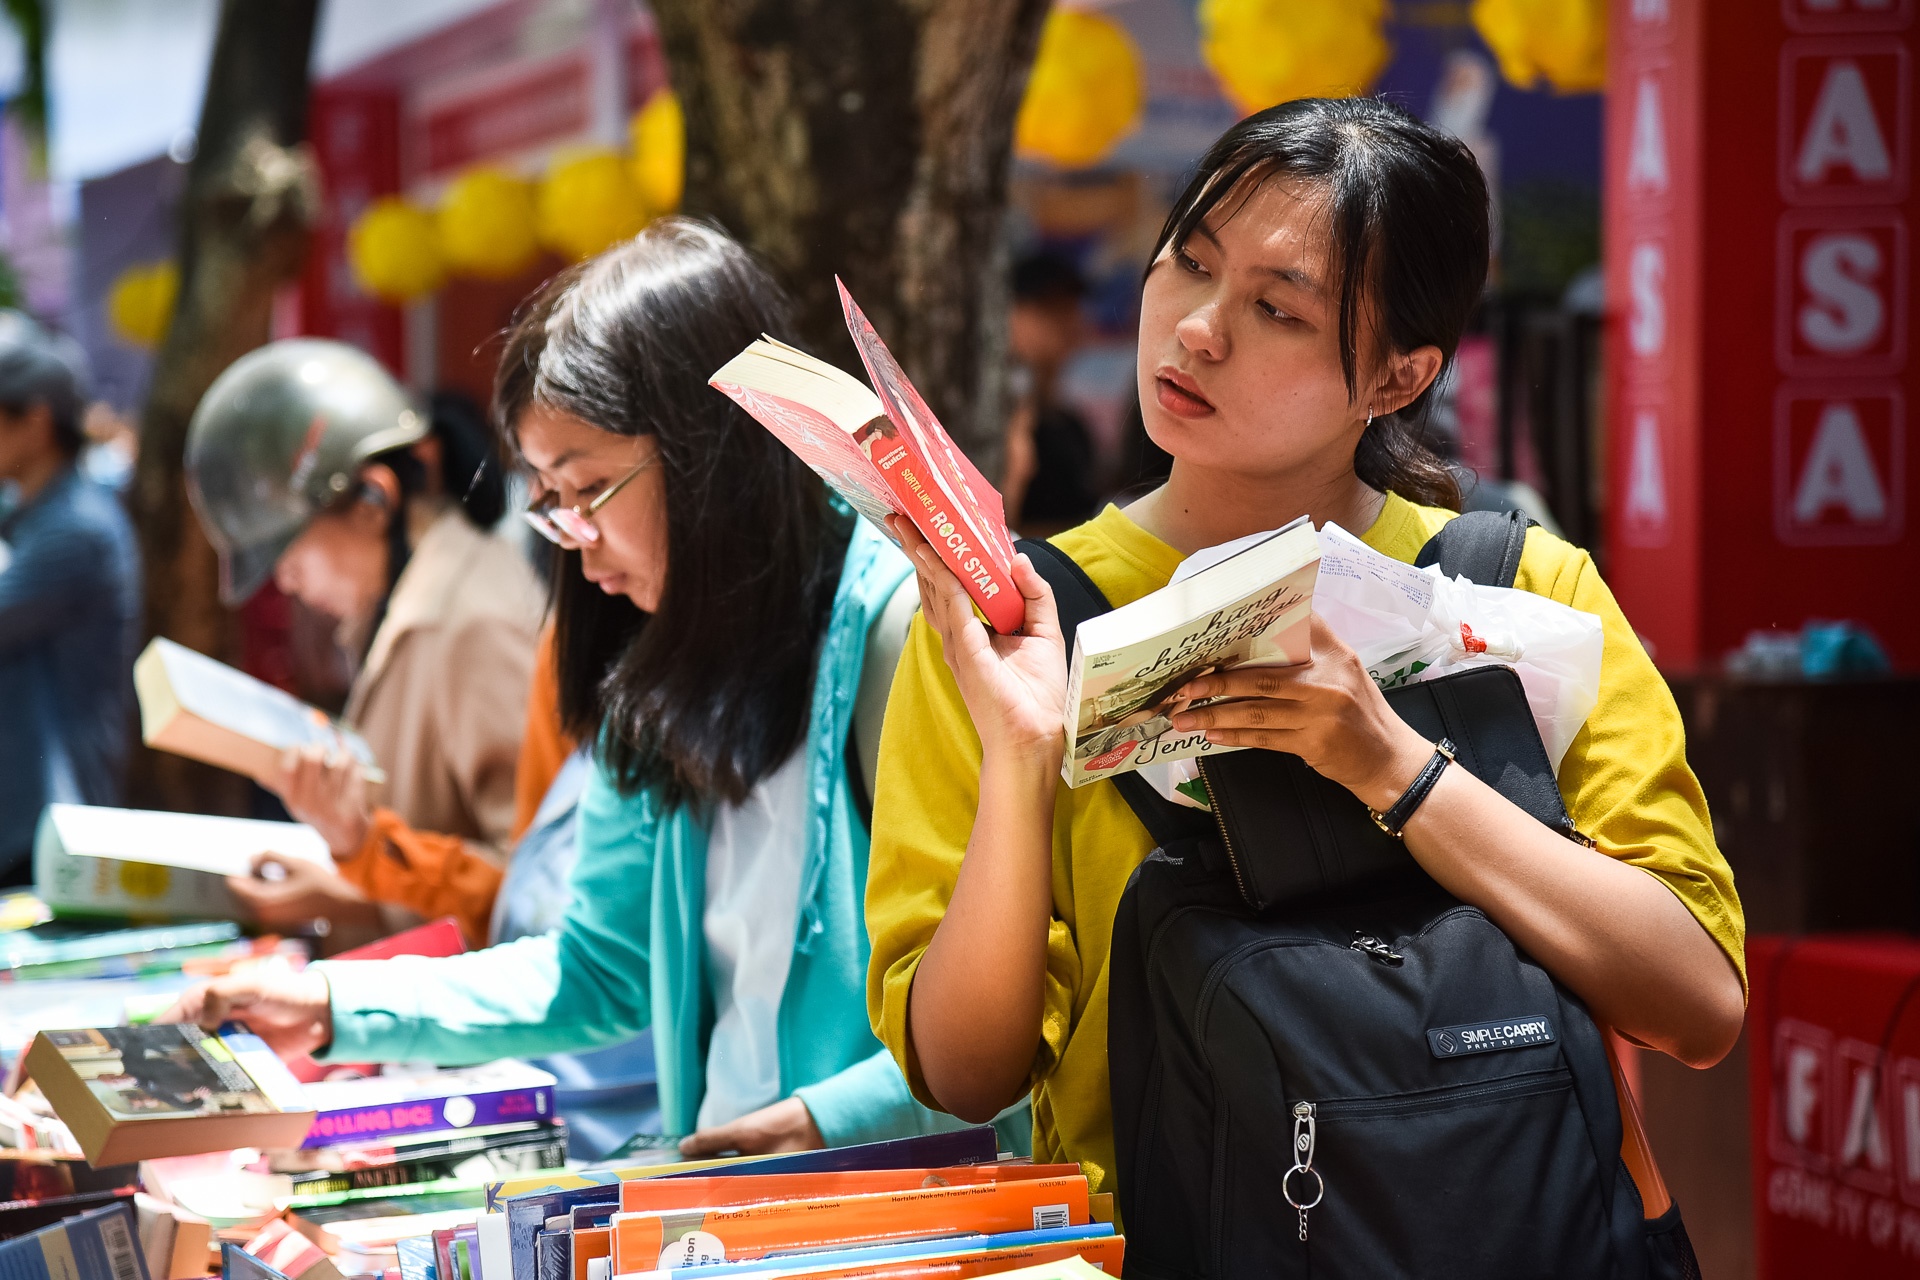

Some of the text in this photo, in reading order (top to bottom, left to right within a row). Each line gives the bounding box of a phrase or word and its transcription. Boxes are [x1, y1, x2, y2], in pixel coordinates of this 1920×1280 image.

[1628, 0, 1670, 521] ASA
[1795, 0, 1893, 522] ASA
[882, 450, 908, 470] Quick
[901, 468, 1000, 600] SORTA LIKE A ROCK STAR
[1238, 593, 1303, 633] trai
[1467, 1034, 1550, 1050] PART OF LIFE
[1038, 1180, 1067, 1189] OXFORD
[713, 1213, 730, 1221] Let's
[732, 1211, 744, 1219] Go
[757, 1208, 769, 1216] 3rd
[769, 1207, 791, 1215] Edition
[807, 1202, 841, 1211] Workbook
[1076, 1243, 1105, 1251] OXFORD
[843, 1270, 876, 1279] Workbook
